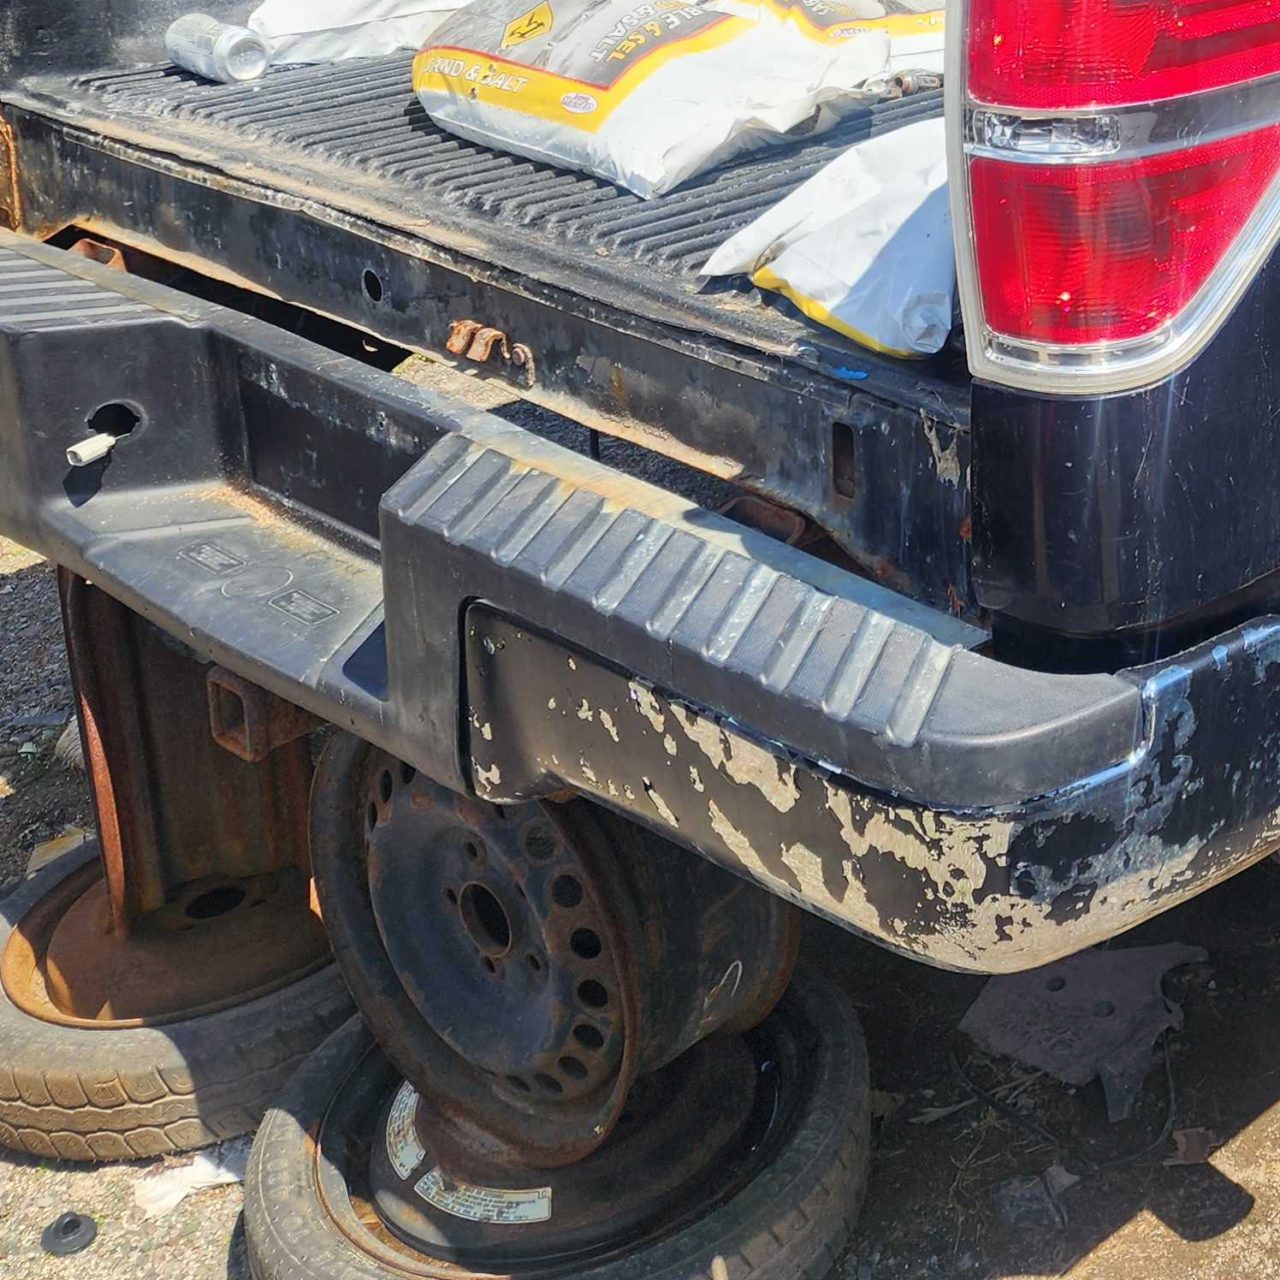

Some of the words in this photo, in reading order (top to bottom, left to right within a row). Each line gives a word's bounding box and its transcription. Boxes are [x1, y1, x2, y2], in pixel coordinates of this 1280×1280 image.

[661, 6, 706, 30] BLE
[588, 14, 640, 62] SALT
[605, 30, 647, 63] SEL
[480, 70, 529, 93] SALT
